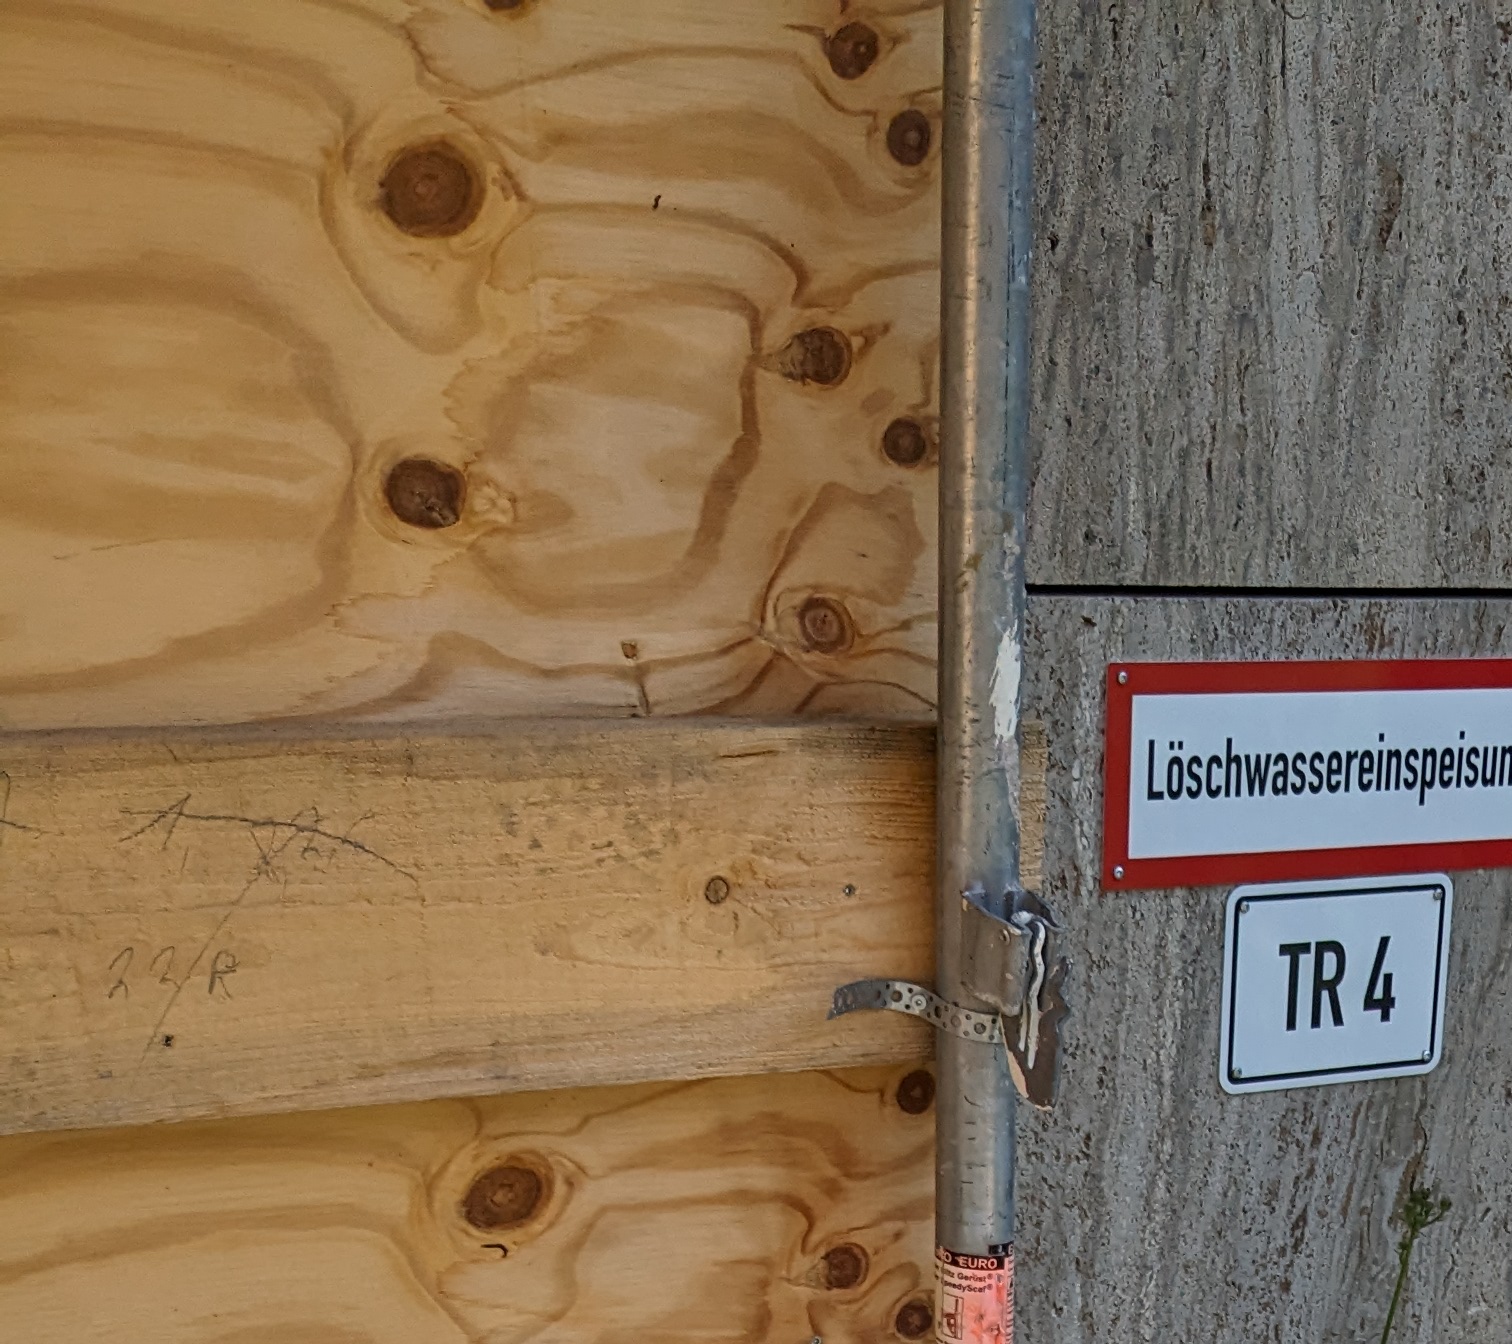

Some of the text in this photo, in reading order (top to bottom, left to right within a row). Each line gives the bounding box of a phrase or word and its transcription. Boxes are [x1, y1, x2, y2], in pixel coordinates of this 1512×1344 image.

[1278, 935, 1396, 1032] TR 4
[959, 1256, 998, 1269] EURO
